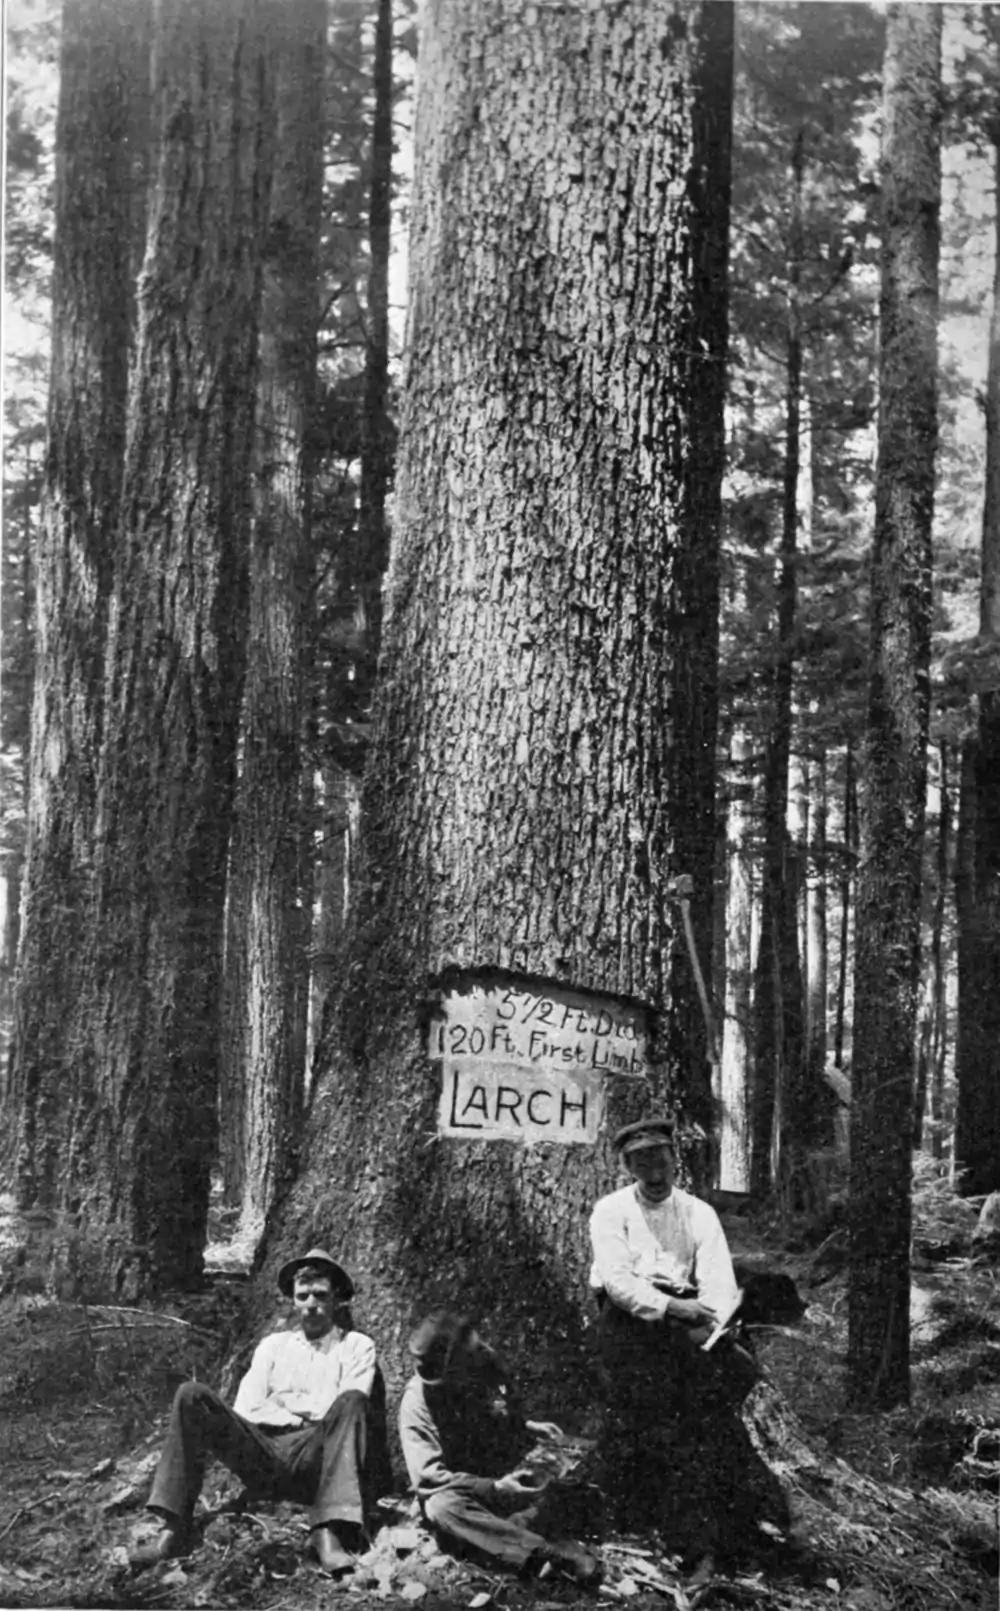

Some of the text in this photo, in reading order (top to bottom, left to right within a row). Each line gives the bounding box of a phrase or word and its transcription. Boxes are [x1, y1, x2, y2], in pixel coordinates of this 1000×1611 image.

[438, 1025, 485, 1055] 120
[529, 1030, 587, 1063] First
[592, 1039, 643, 1074] Limb
[450, 1070, 587, 1130] LARCH
